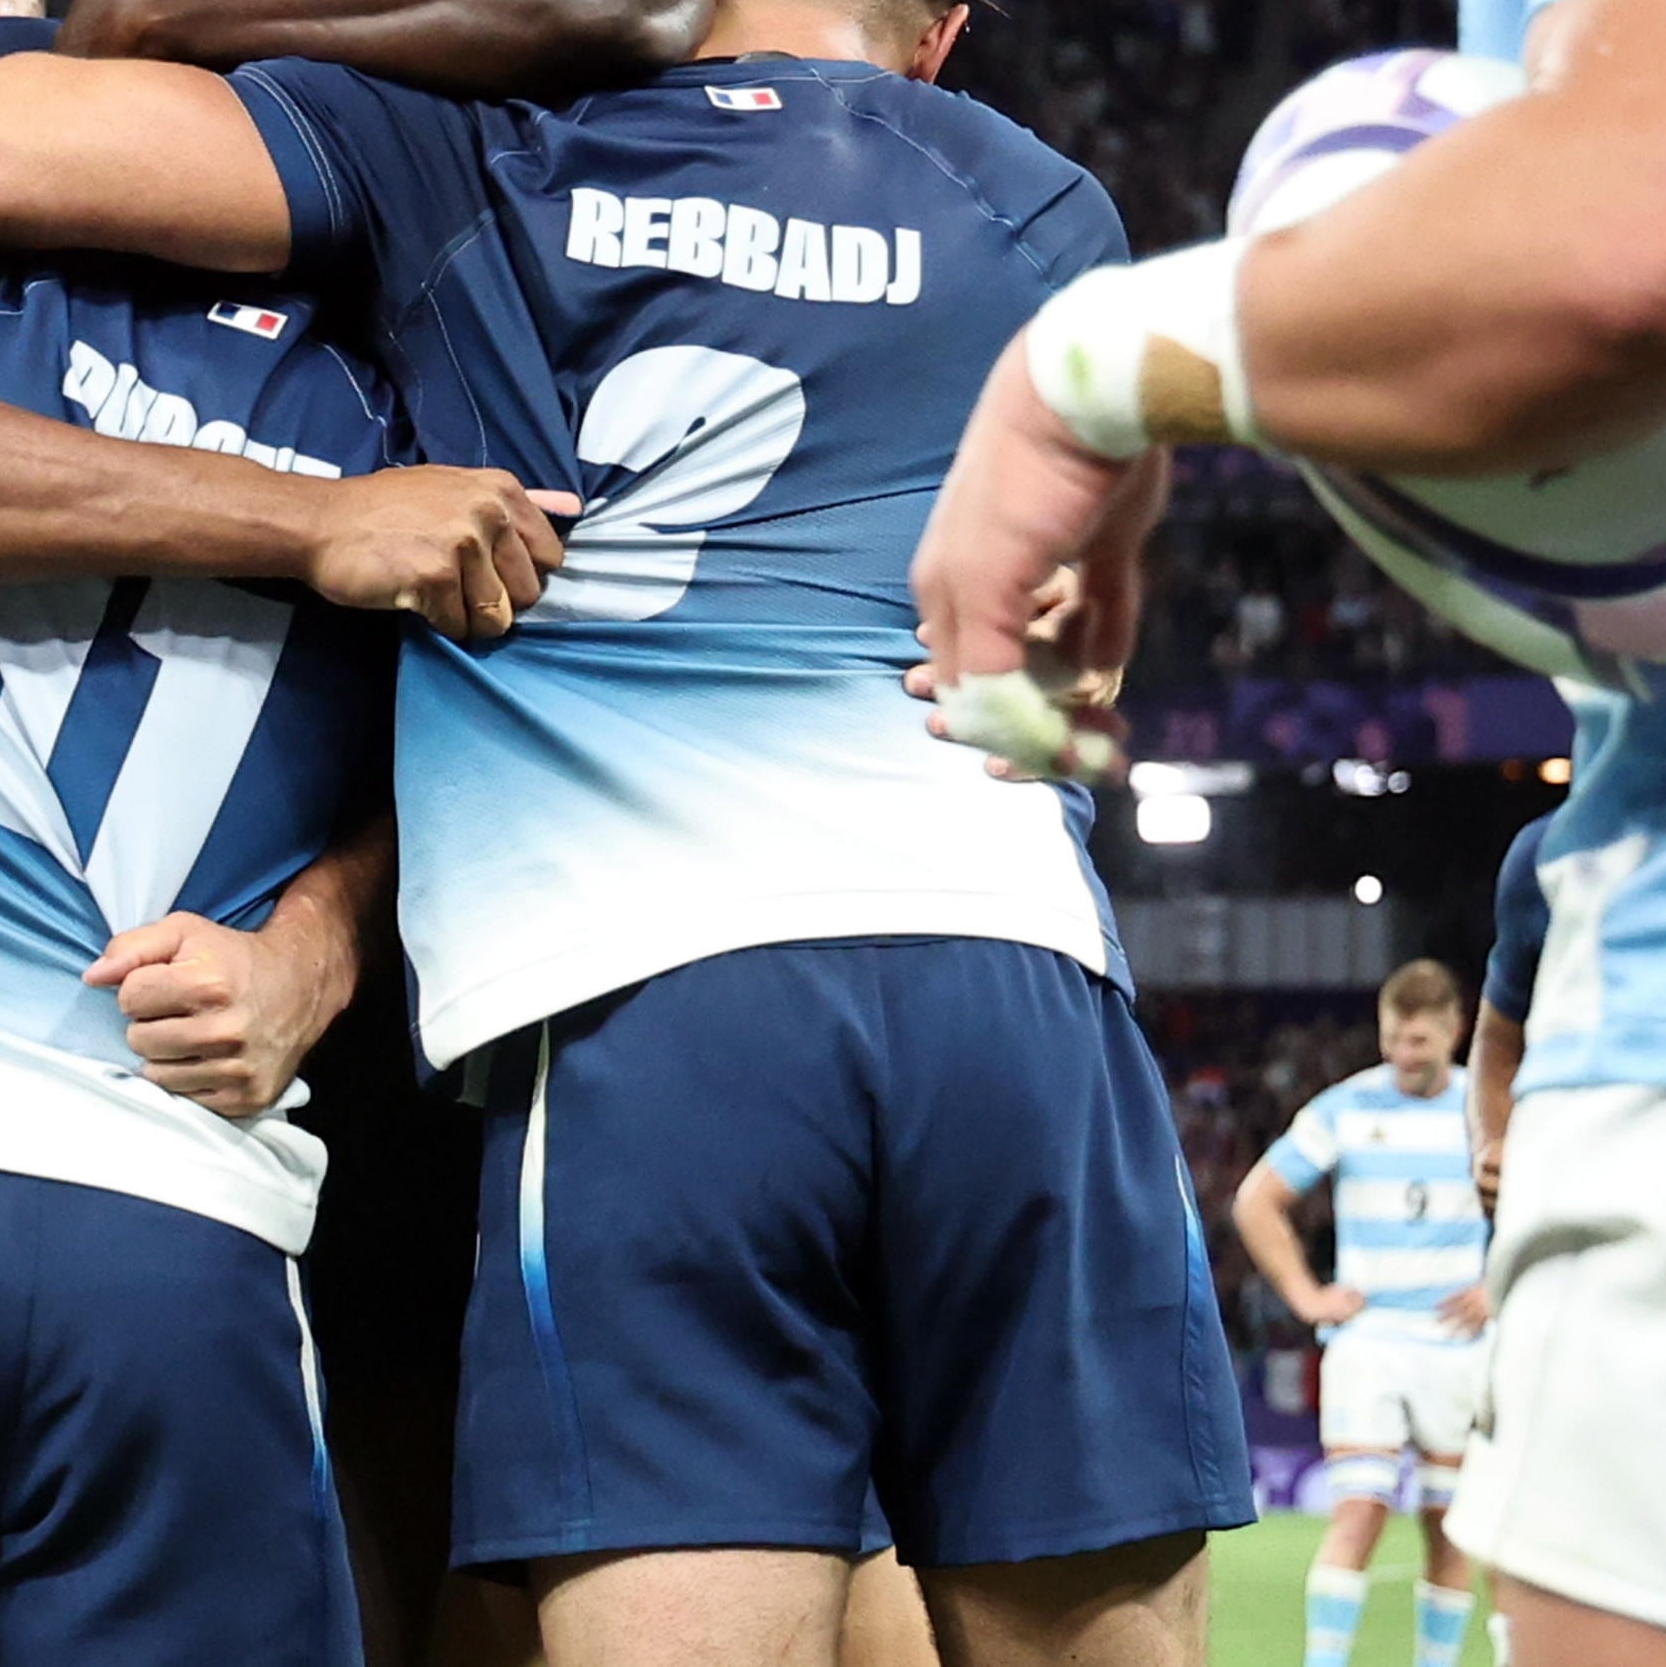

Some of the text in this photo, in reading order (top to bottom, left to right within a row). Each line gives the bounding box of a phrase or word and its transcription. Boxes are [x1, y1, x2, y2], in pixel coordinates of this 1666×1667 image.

[566, 188, 921, 305] REBBADJ
[514, 345, 806, 623] 2
[1404, 1180, 1429, 1225] 9
